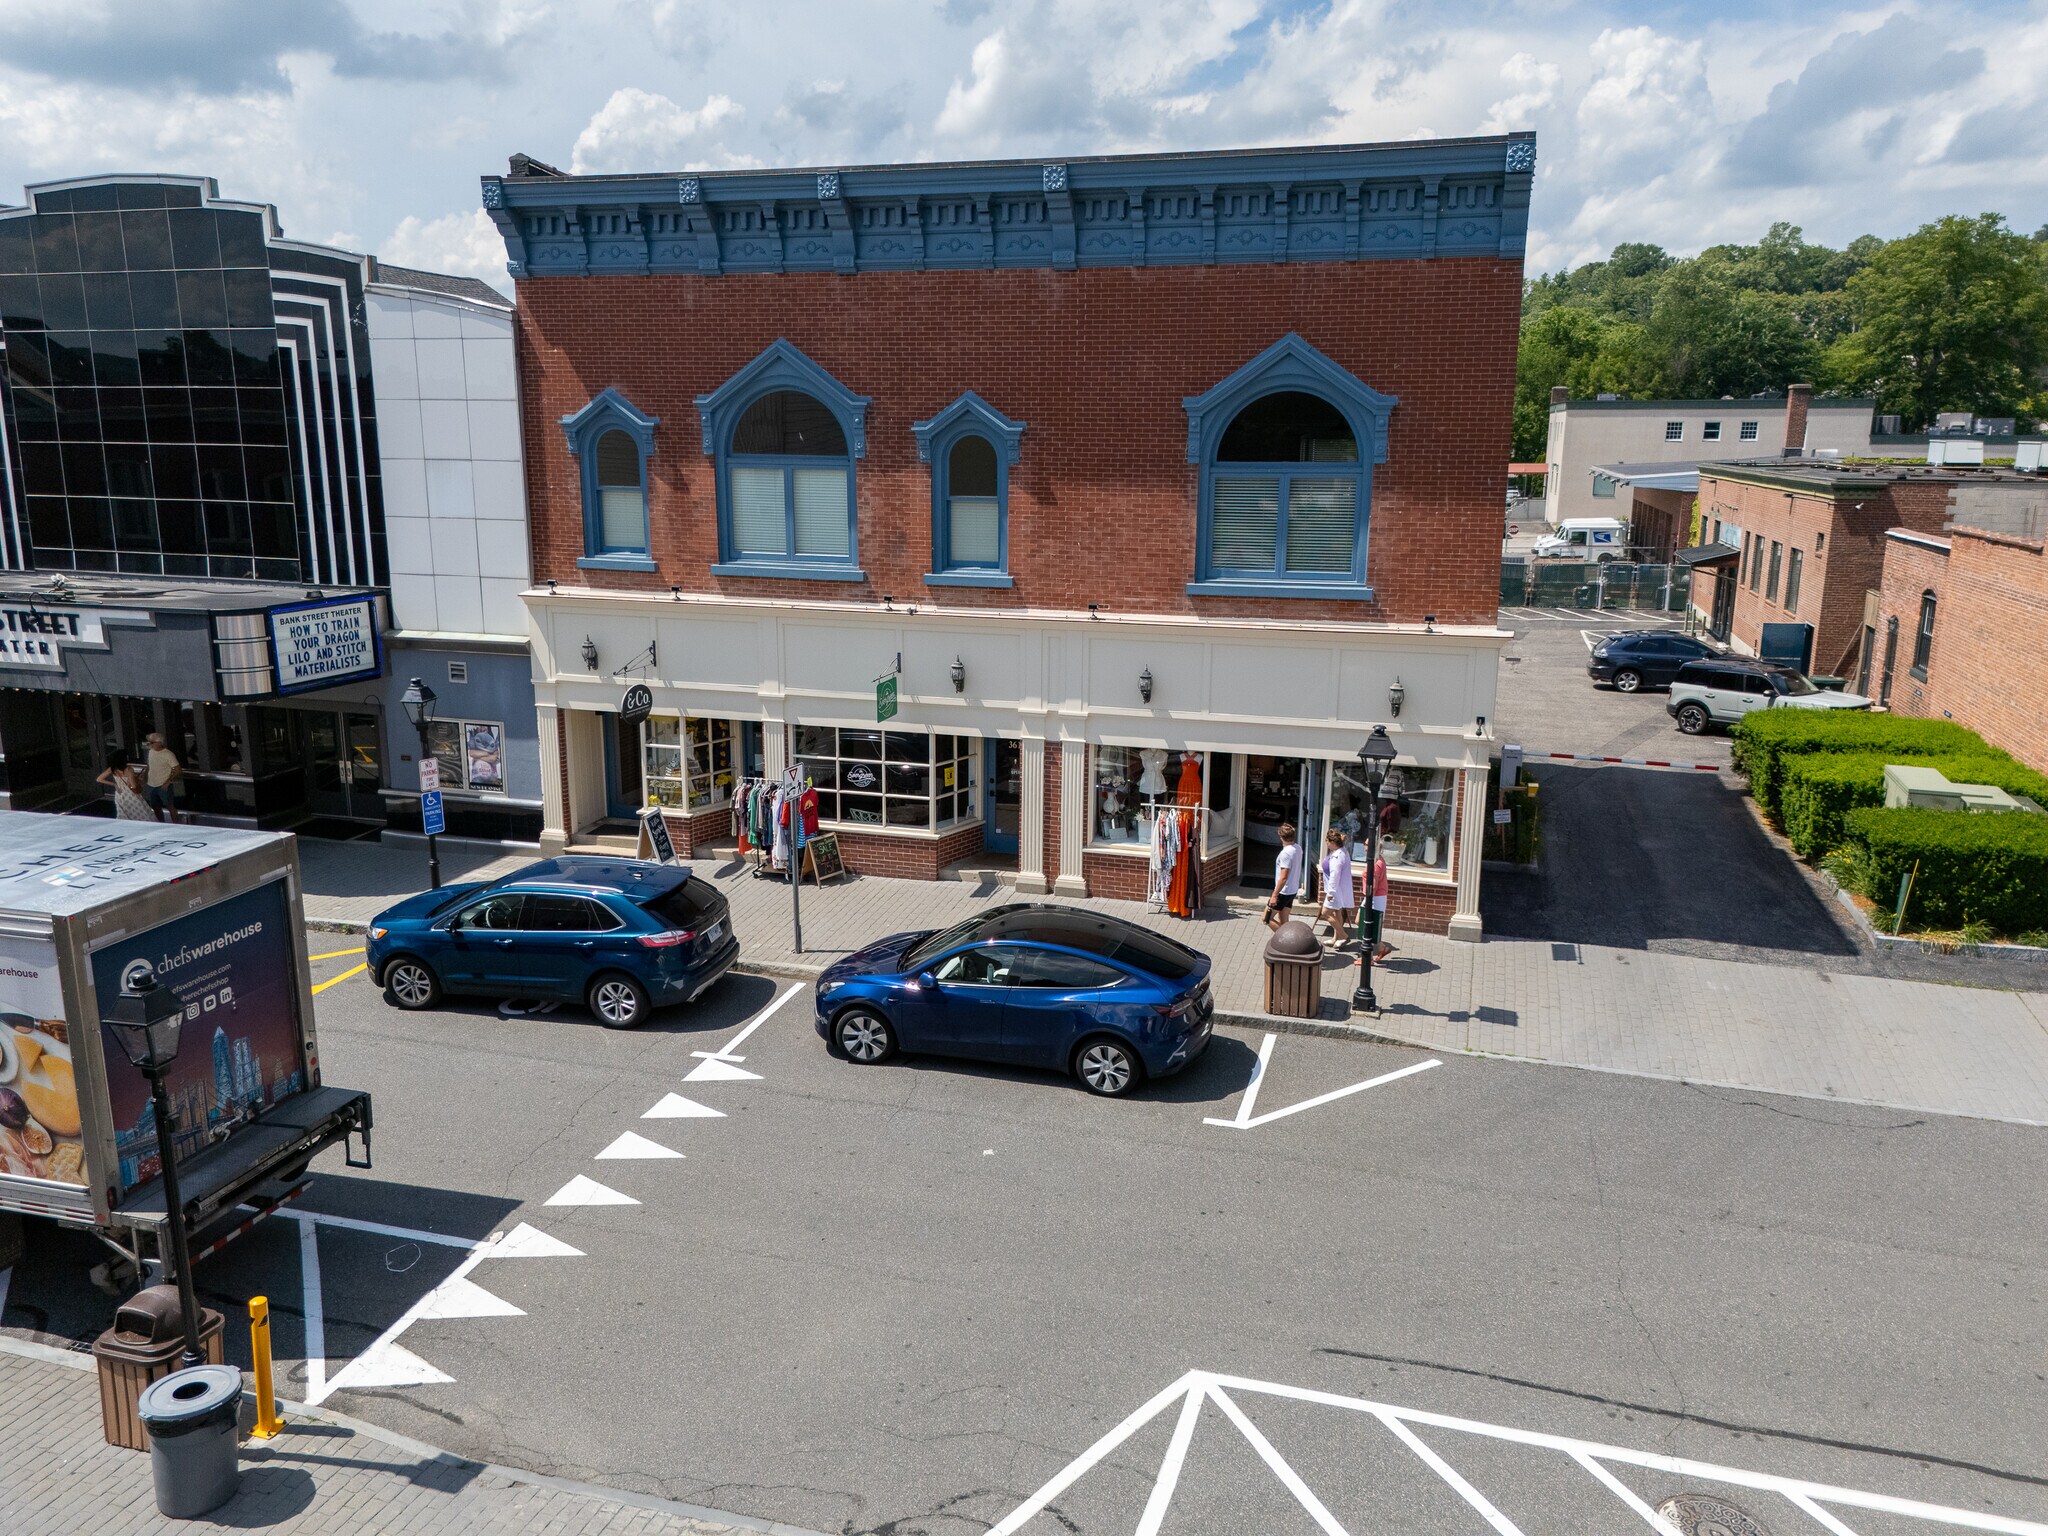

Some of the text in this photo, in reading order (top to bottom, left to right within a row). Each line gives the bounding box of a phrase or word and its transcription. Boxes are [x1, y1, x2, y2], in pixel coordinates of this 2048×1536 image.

[280, 607, 362, 626] BANK STREET THEATER
[290, 617, 360, 638] HOW TO TRAIN
[294, 630, 360, 650] YOUR DRAGON
[288, 641, 367, 665] LILO AND STITCH
[295, 655, 361, 677] MATERIALISTS
[421, 769, 438, 777] PARKING
[82, 839, 185, 869] Nasdaq
[819, 843, 833, 855] SALE
[67, 841, 208, 889] LISTED
[157, 921, 263, 975] chefswarehouse
[0, 967, 38, 978] arehouse
[171, 963, 232, 995] efswarehouse.com
